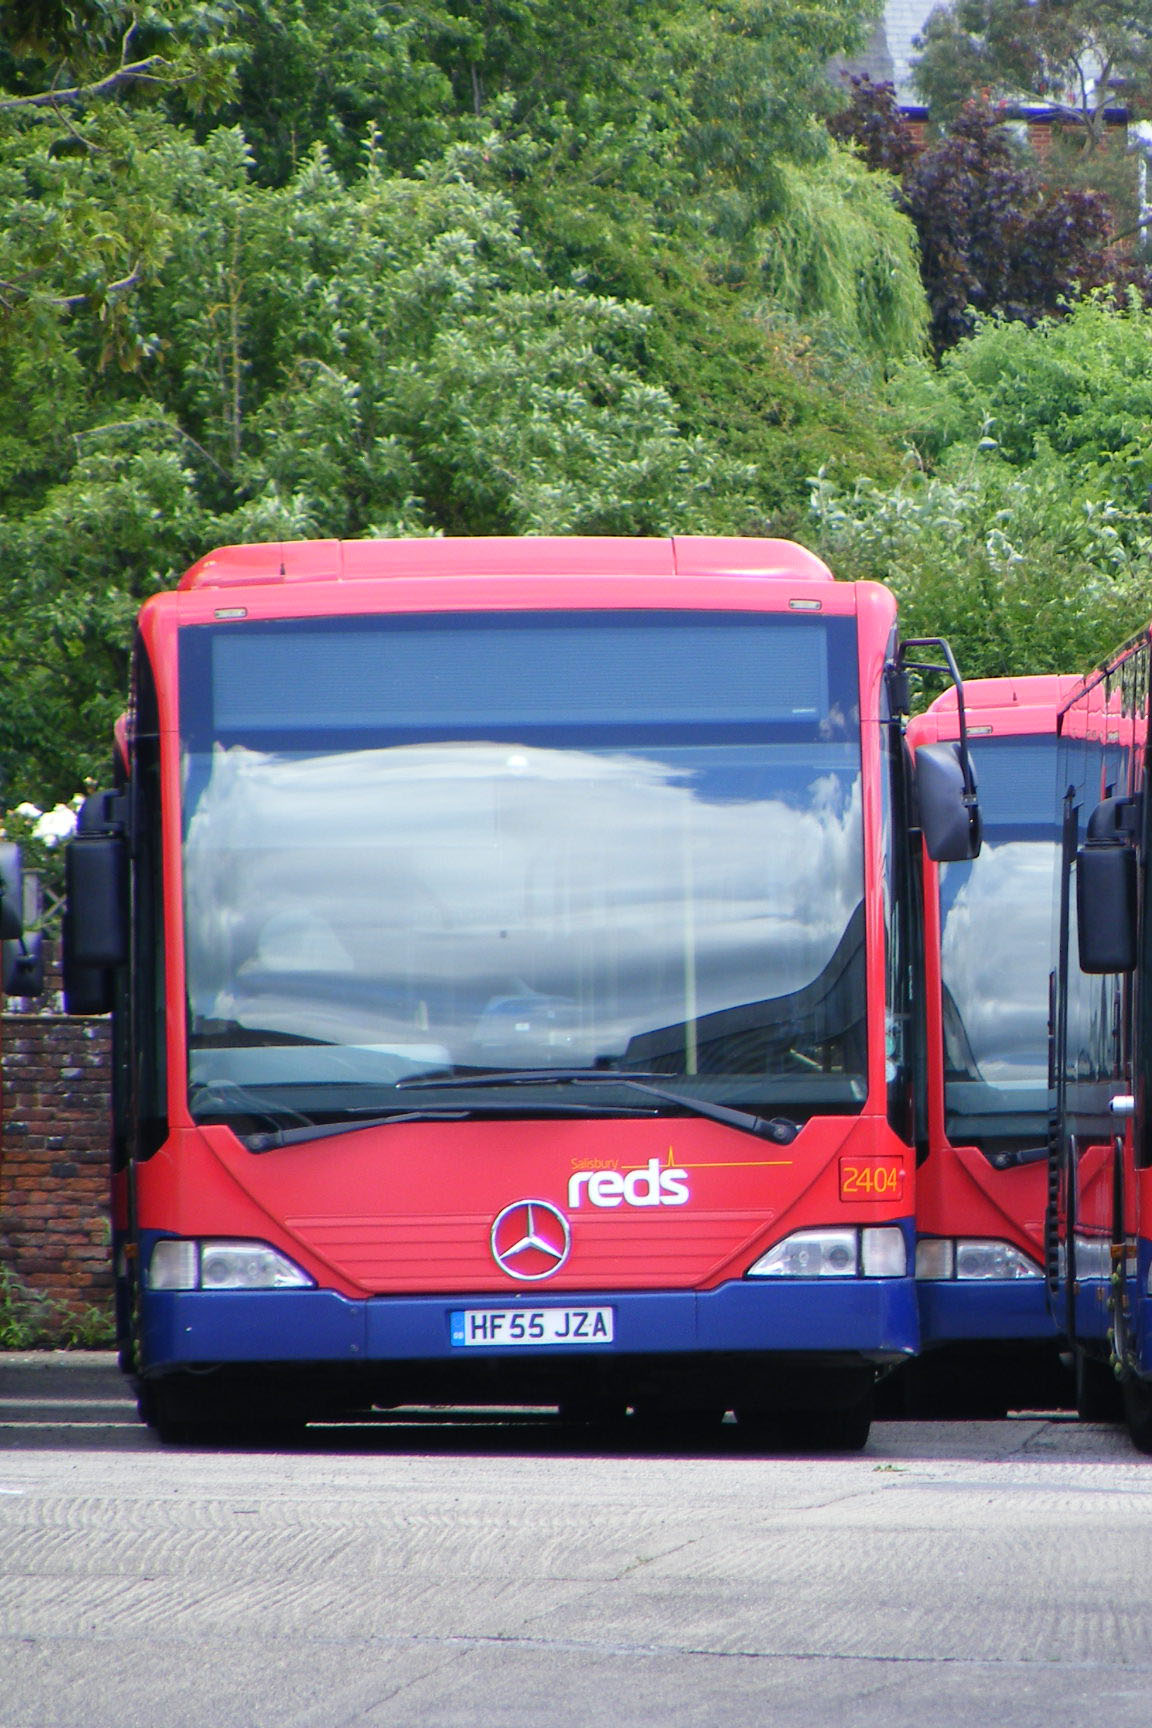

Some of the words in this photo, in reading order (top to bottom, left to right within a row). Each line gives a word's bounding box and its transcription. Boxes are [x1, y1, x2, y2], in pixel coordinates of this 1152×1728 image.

[571, 1157, 619, 1171] Salisbury
[567, 1158, 690, 1208] reds
[842, 1167, 897, 1192] 2404
[470, 1313, 544, 1339] HF55
[554, 1312, 607, 1338] JZA
